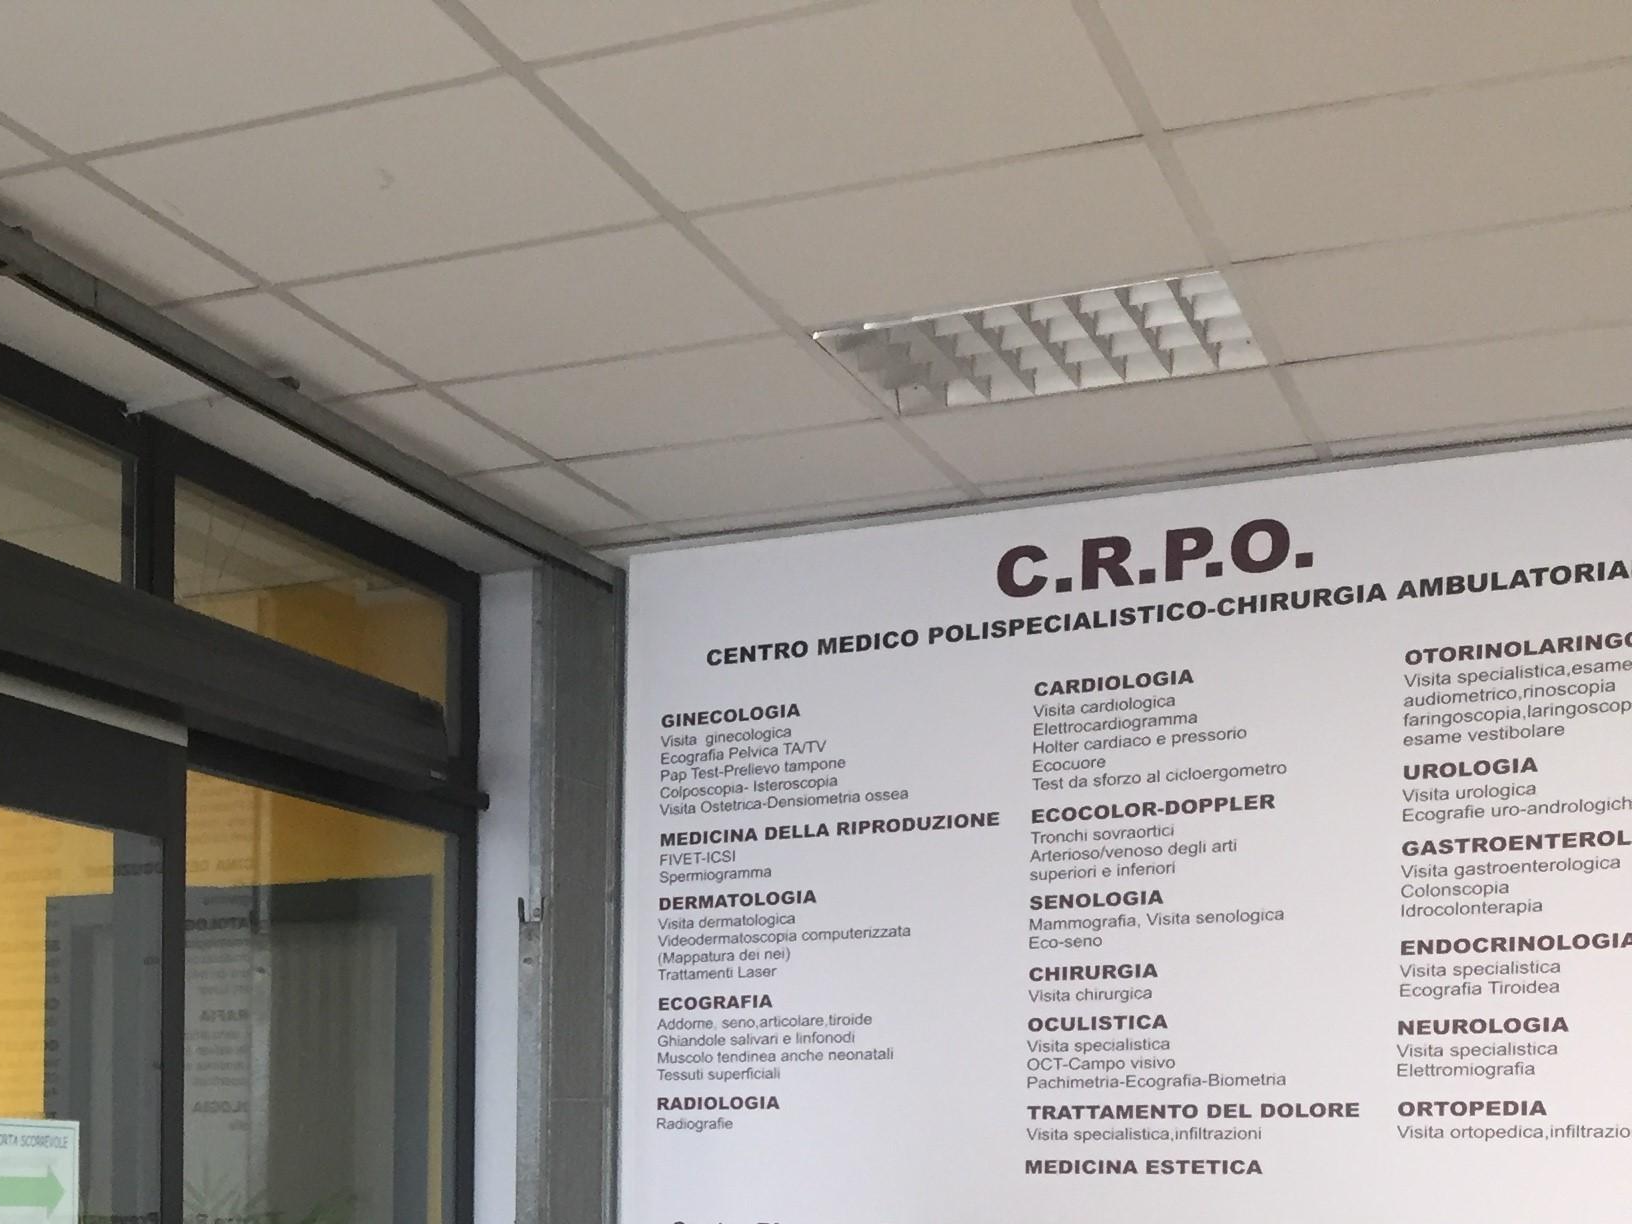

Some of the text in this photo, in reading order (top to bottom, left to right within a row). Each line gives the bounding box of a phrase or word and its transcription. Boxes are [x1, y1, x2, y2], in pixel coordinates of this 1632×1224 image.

[997, 518, 1313, 598] C.R.P.O.
[707, 560, 1632, 666] CENTRO MEDICO POLISPECIALISTICO-CHIRURGIA AMBULATORIA
[1034, 669, 1194, 696] CARDIOLOGIA
[1404, 677, 1615, 707] audiometrico,rinoscopia
[661, 704, 800, 728] GINECOLOGIA
[1033, 713, 1197, 736] Elettrocardiogramma
[661, 727, 792, 750] Visita ginecologica
[1403, 724, 1564, 747] esame vestibolare
[661, 740, 826, 766] Ecografia Pelvica TA/TV
[661, 759, 846, 783] Pap Test-Prelievo tampone
[1033, 758, 1106, 772] Ecocuore
[1404, 757, 1538, 780] UROLOGIA
[754, 777, 838, 792] Isteroscopia
[1032, 794, 1275, 824] ECOCOLOR-DOPPLER
[661, 812, 999, 847] MEDICINA DELLA RIPRODUZIONE
[1030, 825, 1174, 844] Tronchi sovraortici
[1030, 839, 1237, 862] Arterioso/venoso degli arti
[1402, 830, 1632, 856] GASTROENTEROL
[660, 850, 735, 866] FIVET-ICSI
[660, 868, 771, 885] Spermiogramma
[1401, 858, 1620, 880] Visita gastroenterologica
[1401, 882, 1509, 898] Colonscopia
[659, 890, 816, 911] DERMATOLOGIA
[1030, 890, 1163, 910] SENOLOGIA
[1401, 899, 1542, 917] Idrocolonterapia
[658, 913, 795, 930] Visita dermatologica
[1029, 909, 1284, 931] Mammografia, Visita senologica
[658, 926, 911, 947] Videodermatoscopia computerizzata
[1029, 936, 1102, 949] Eco-seno
[658, 947, 790, 966] (Mappatura dei nei)
[658, 966, 777, 980] Trattamenti Laser
[1029, 963, 1158, 982] CHIRURGIA
[1400, 961, 1560, 979] Visita specialistica
[1400, 980, 1559, 1000] Ecografia Tiroidea
[659, 994, 772, 1011] ECOGRAFIA
[1028, 1014, 1168, 1032] OCULISTICA
[1398, 1017, 1569, 1035] NEUROLOGIA
[658, 1031, 855, 1047] Ghiandole salivari e linfonodi
[658, 1048, 893, 1064] Muscolo tendinea anche neonatali
[1027, 1057, 1175, 1072] OCT-Campo visivo
[657, 1067, 780, 1082] Tessuti superficiali
[1397, 1062, 1535, 1079] Elettromiografia
[1027, 1074, 1286, 1090] Pachimetria-Ecografia-Biometria
[657, 1096, 780, 1110] RADIOLOGIA
[1027, 1103, 1359, 1120] TRATTAMENTO DEL DOLORE
[1398, 1100, 1547, 1117] ORTOPEDIA
[657, 1117, 733, 1133] Radiografie
[21, 1135, 68, 1149] SCORREVOLE
[1026, 1160, 1263, 1175] MEDICINA ESTETICA
